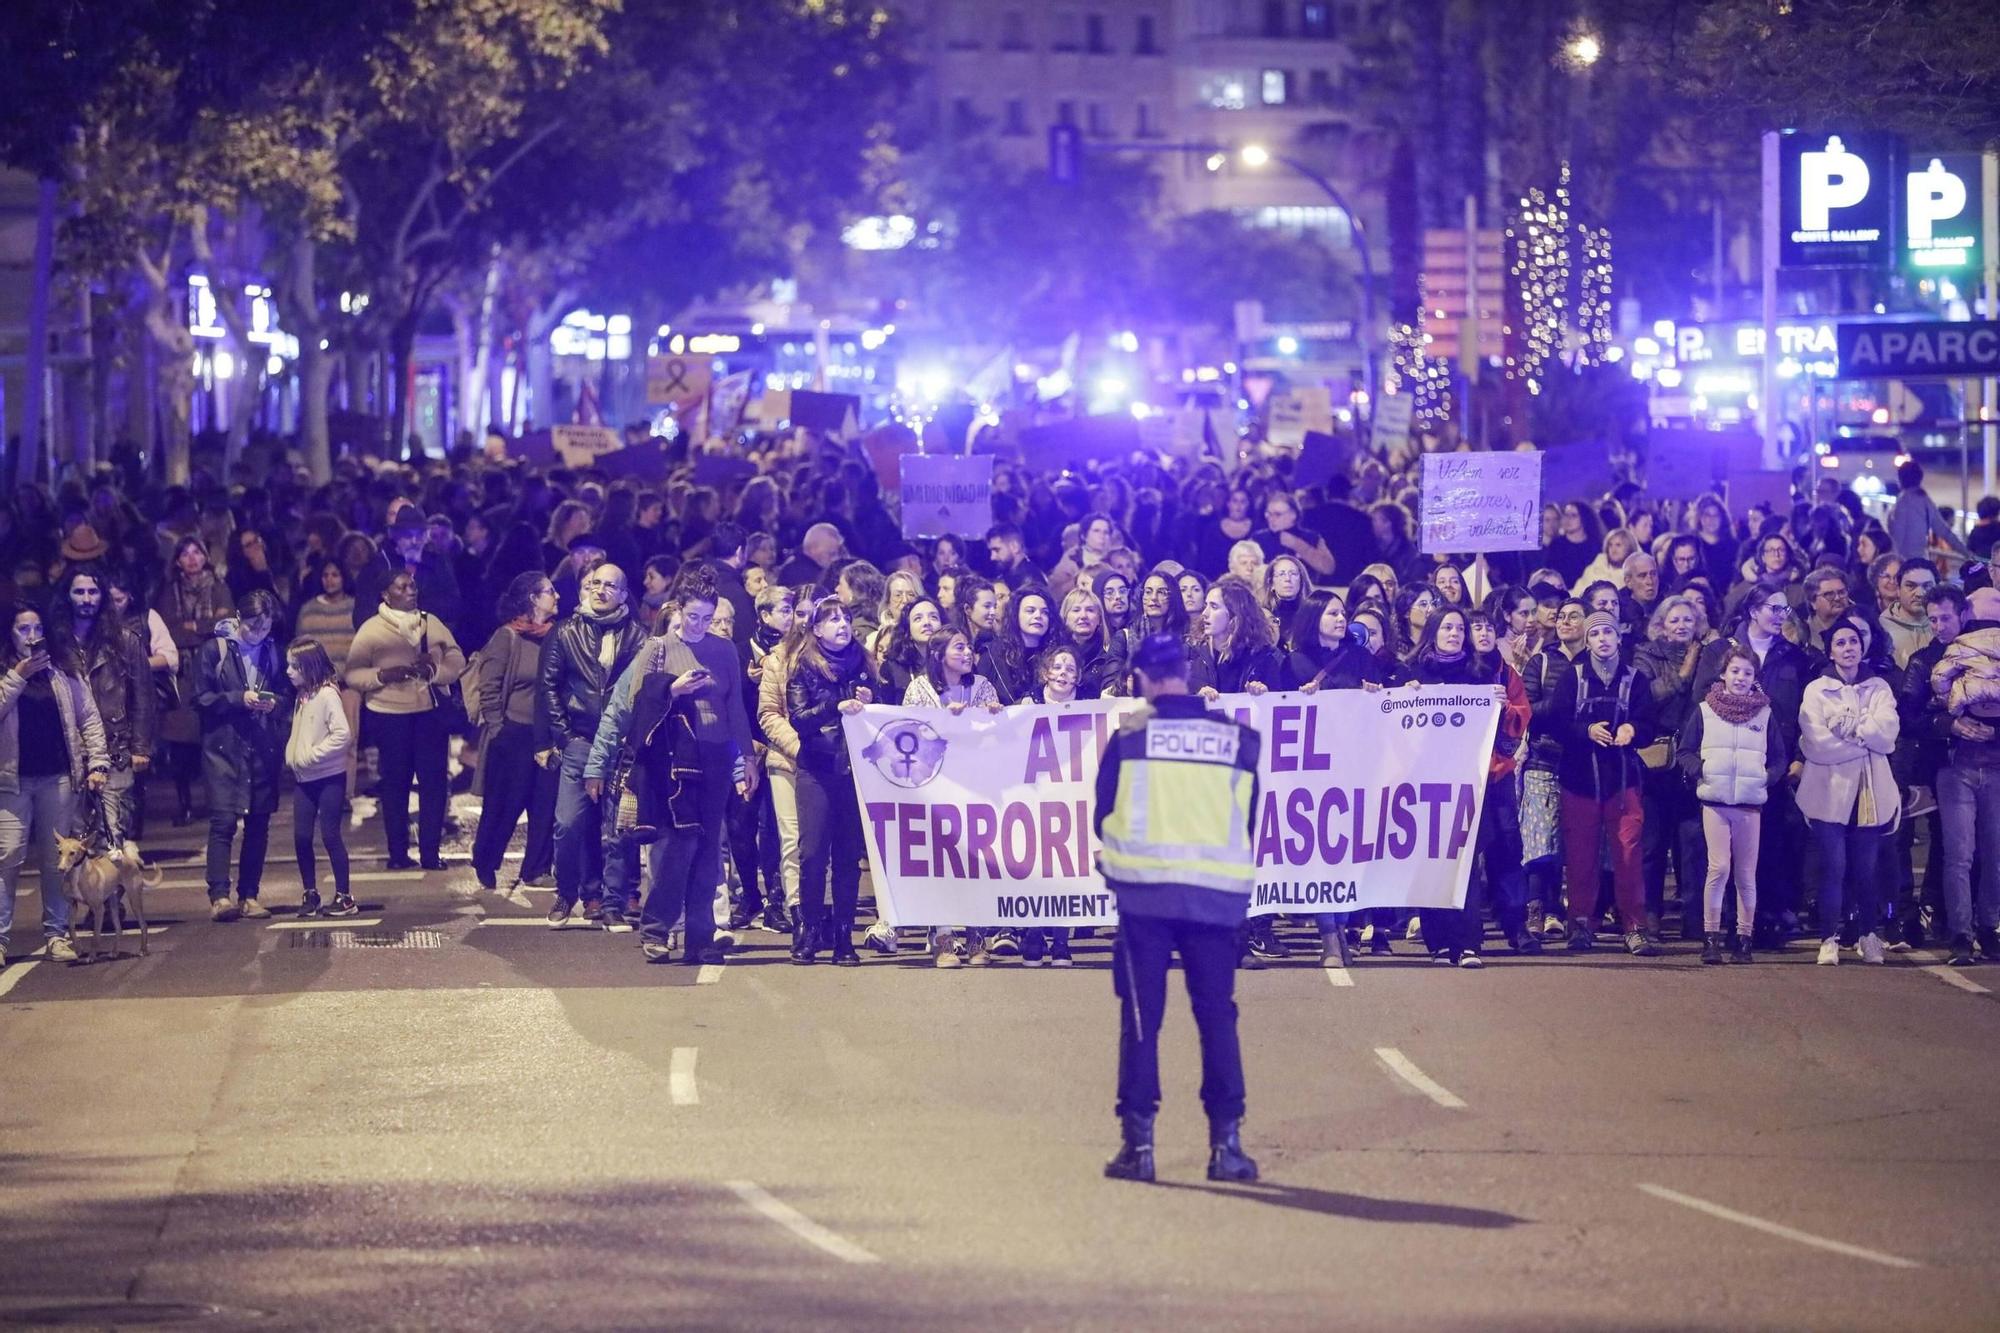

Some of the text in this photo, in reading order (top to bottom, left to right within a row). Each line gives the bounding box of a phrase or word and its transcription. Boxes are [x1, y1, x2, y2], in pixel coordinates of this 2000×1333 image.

[1851, 328, 2000, 366] APARC
[1381, 694, 1491, 714] @movfemmallorca
[1151, 733, 1232, 758] POLICIA
[1271, 705, 1331, 773] EL
[866, 782, 1476, 880] TERRORI ASCLISTA
[997, 880, 1359, 919] MOVIMENT MALLORCA
